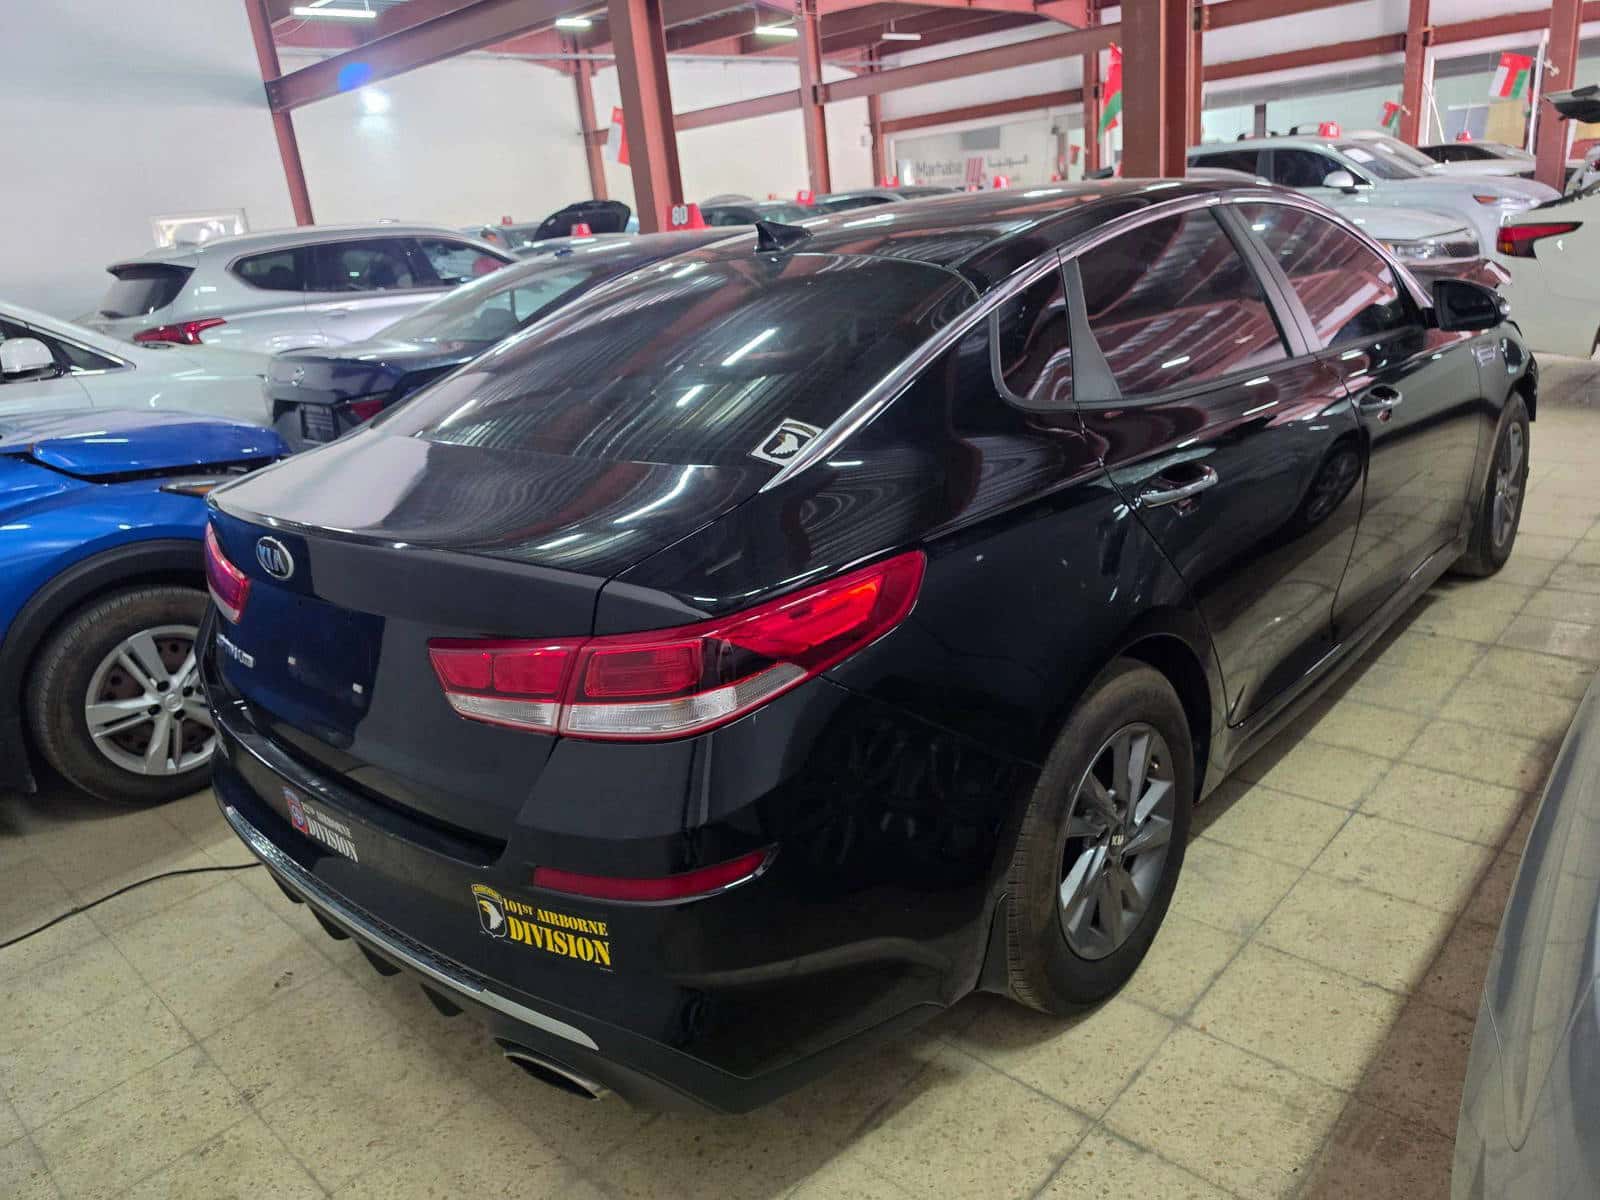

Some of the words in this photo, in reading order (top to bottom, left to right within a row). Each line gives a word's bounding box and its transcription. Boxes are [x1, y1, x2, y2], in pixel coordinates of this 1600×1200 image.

[257, 540, 291, 576] KIA
[306, 815, 359, 863] DIVISION
[504, 898, 533, 915] 101ST
[537, 908, 609, 937] AIRBORNE
[507, 915, 612, 967] DIVISION
